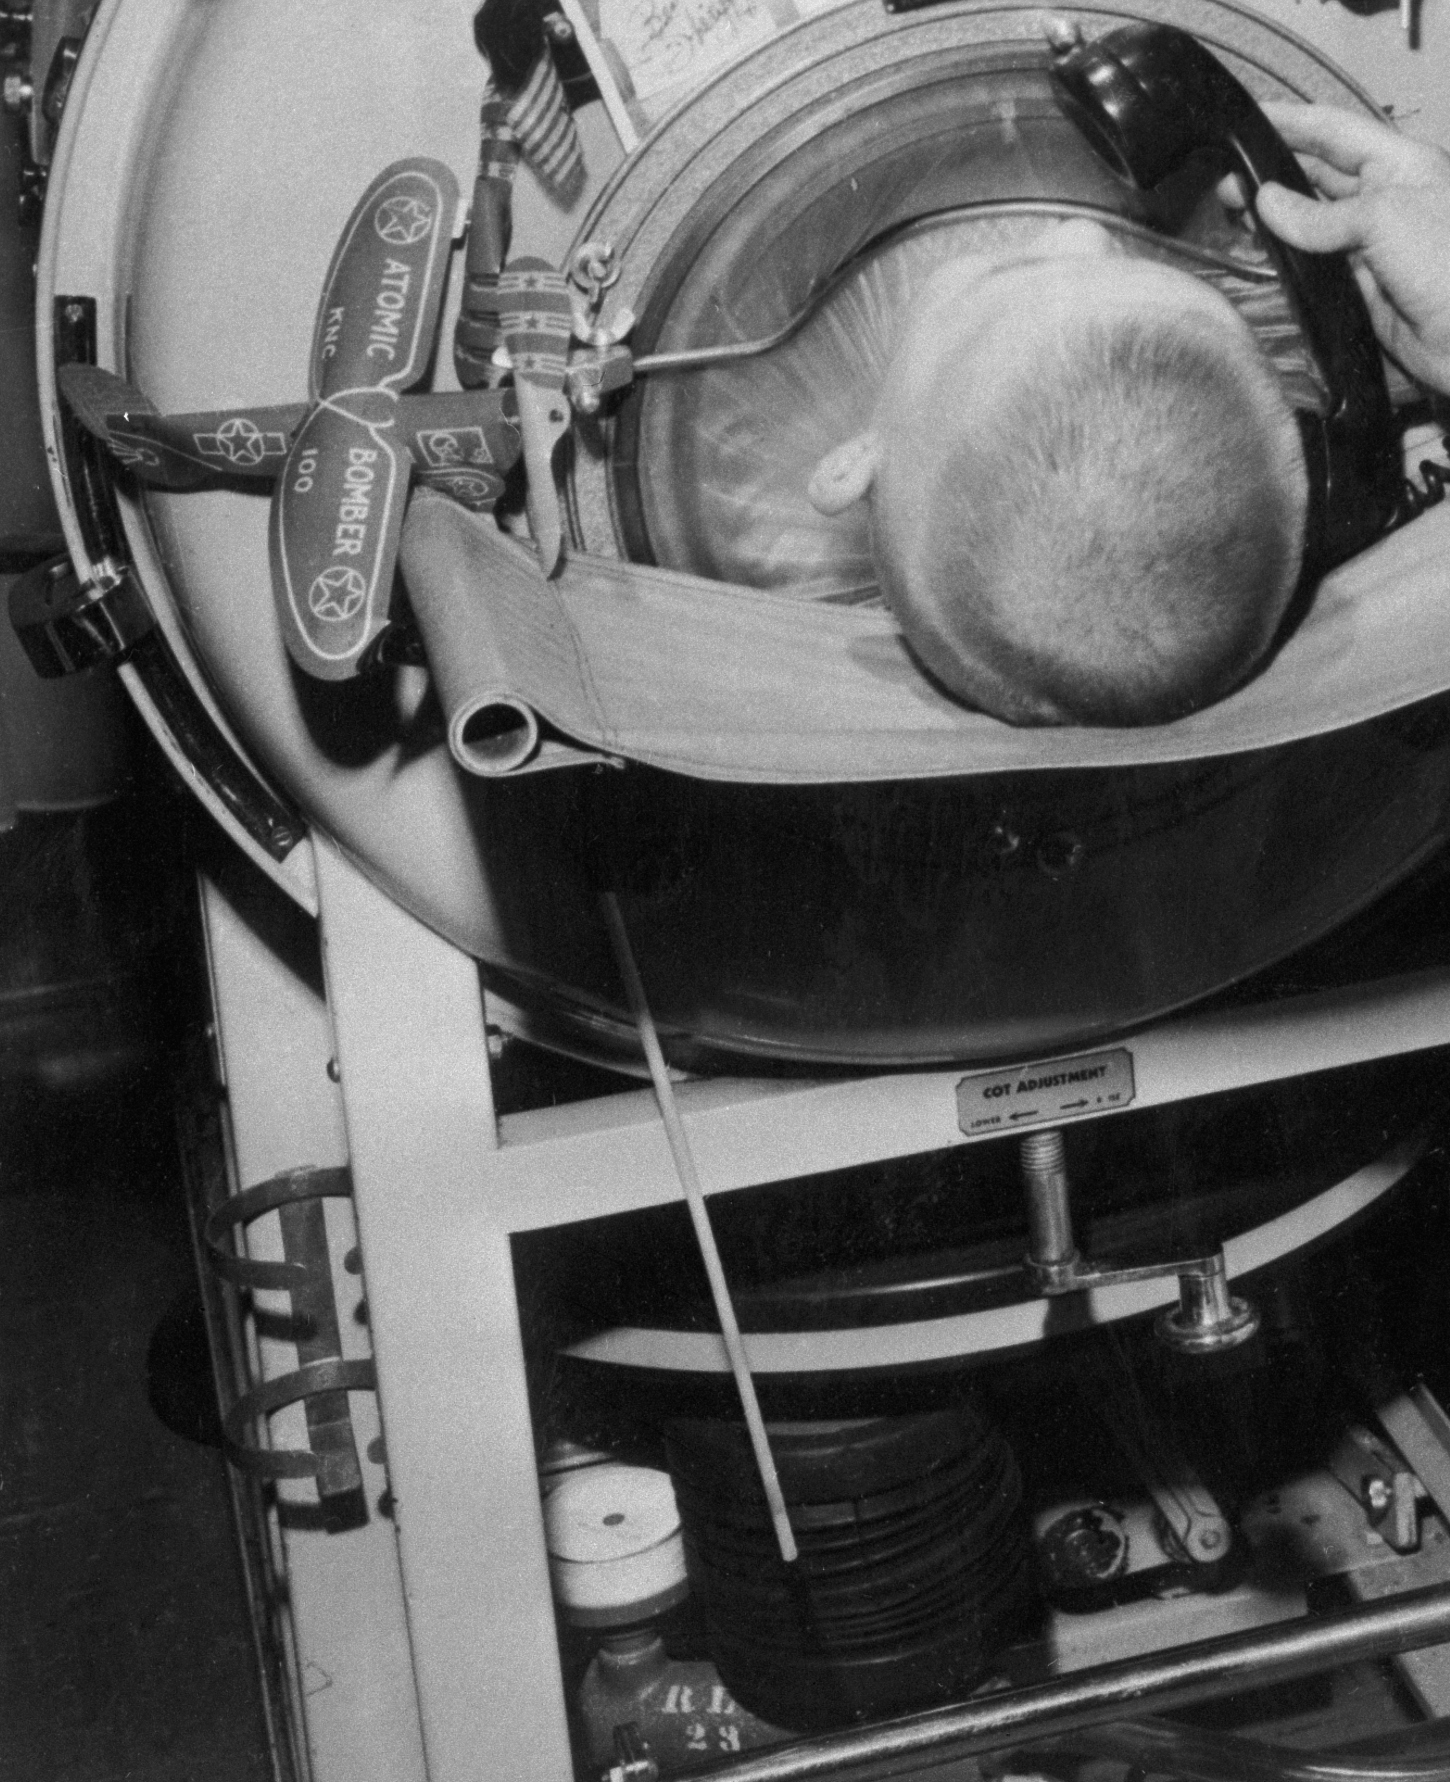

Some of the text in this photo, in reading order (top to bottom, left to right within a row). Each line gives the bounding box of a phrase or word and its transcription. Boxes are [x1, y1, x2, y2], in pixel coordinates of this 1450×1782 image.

[321, 306, 345, 359] KNC
[366, 258, 411, 361] ATOMIC
[294, 448, 319, 493] 100
[332, 447, 378, 556] BOMBER
[983, 1066, 1107, 1099] COT ADJUSTMENT
[970, 1115, 1002, 1129] LOWER
